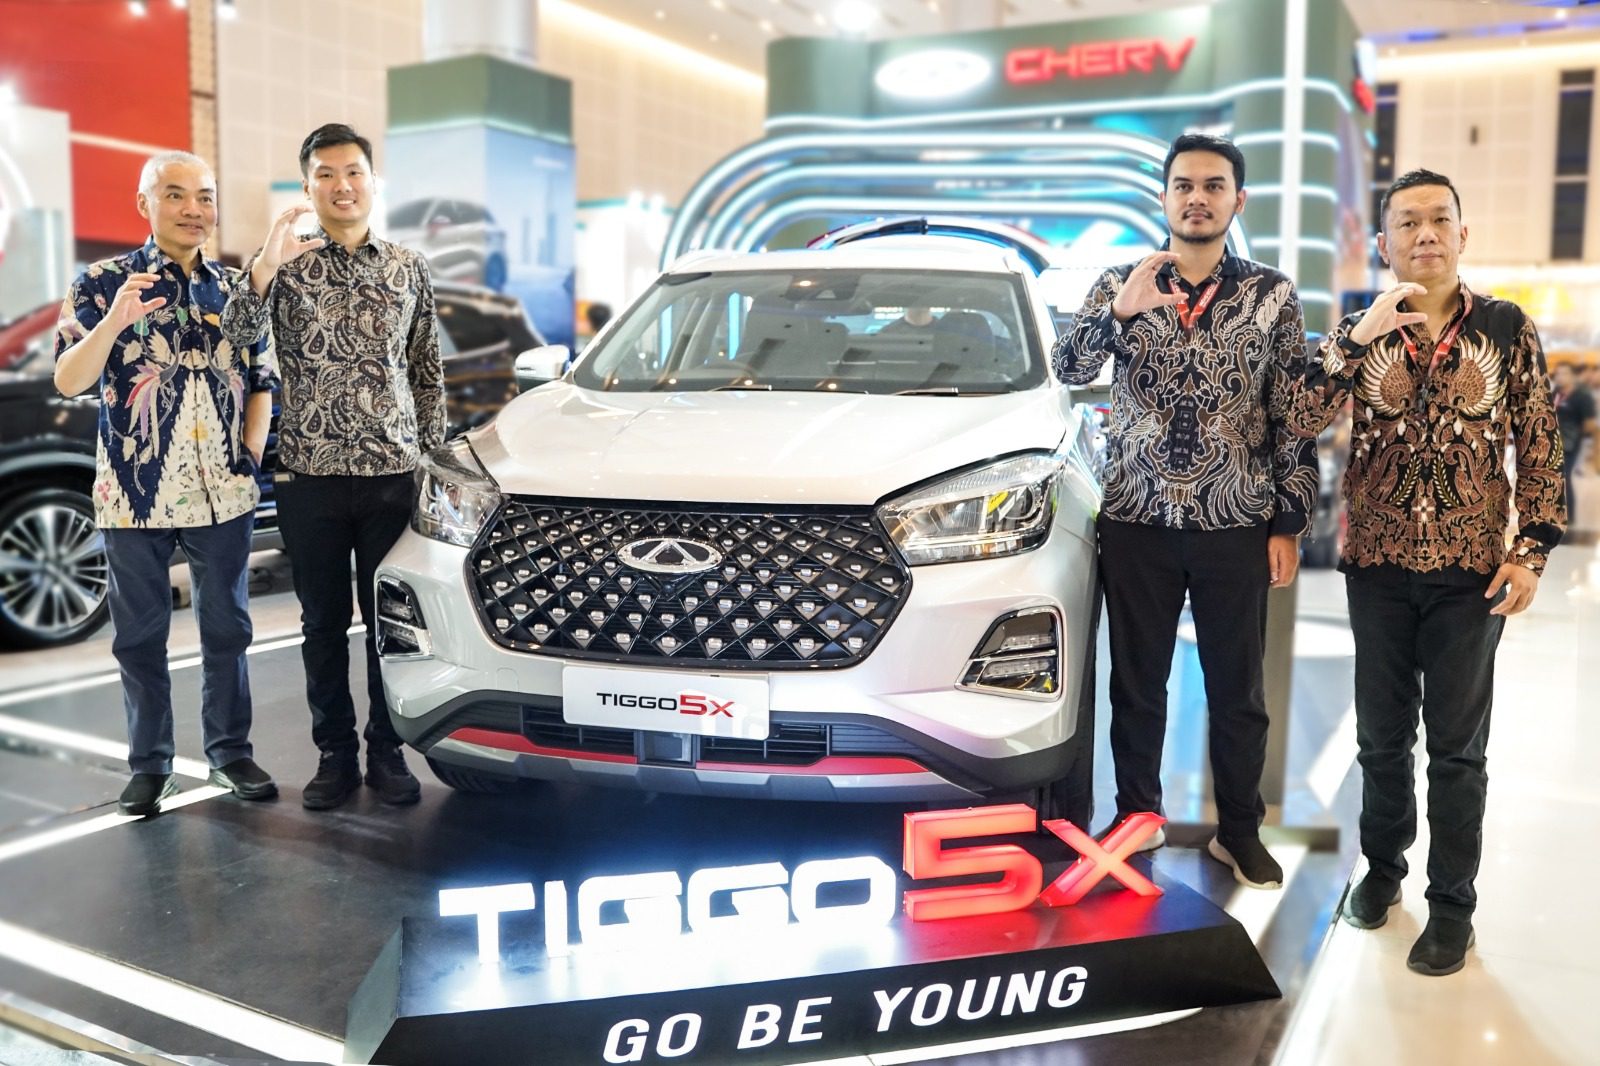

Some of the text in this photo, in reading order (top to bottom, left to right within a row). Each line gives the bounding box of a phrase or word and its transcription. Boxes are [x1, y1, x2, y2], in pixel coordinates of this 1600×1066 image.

[1004, 37, 1195, 82] CHERY
[603, 966, 1088, 1064] GO BE YOUNG
